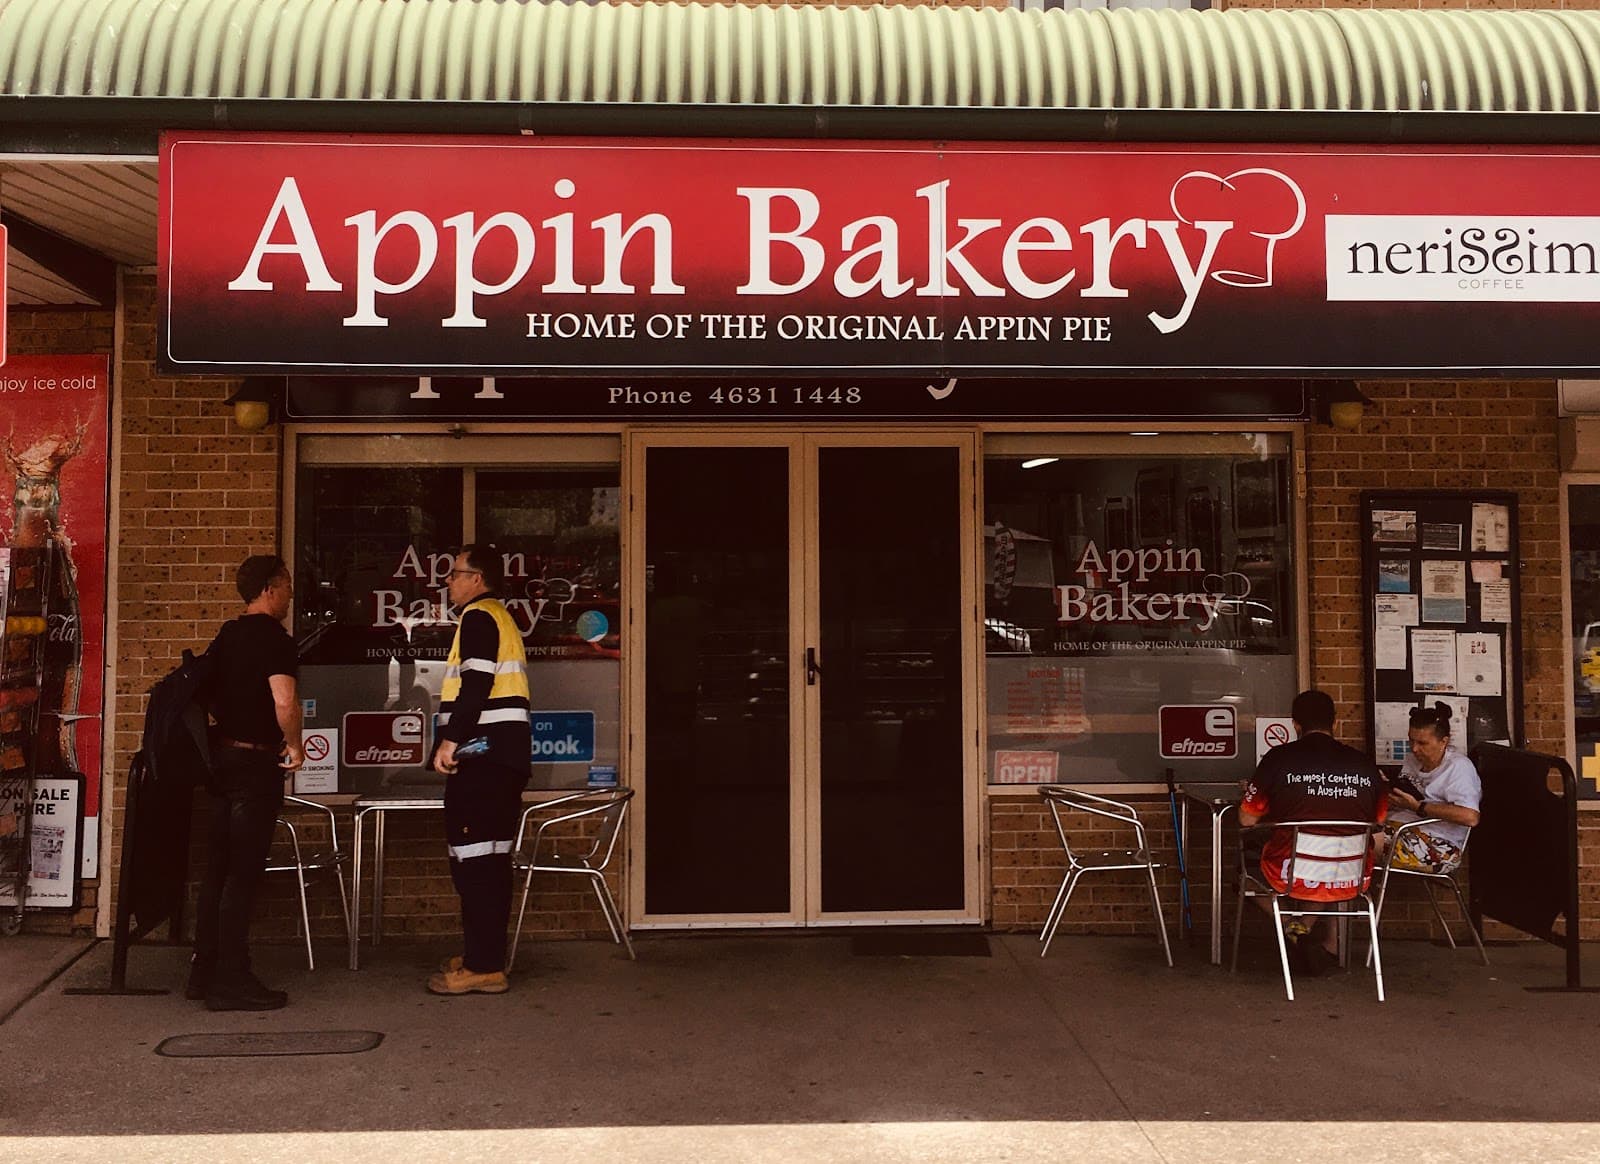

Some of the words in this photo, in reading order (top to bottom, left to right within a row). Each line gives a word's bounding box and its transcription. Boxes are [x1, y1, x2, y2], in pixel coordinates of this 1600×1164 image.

[228, 177, 686, 328] Appin
[736, 178, 1233, 334] Bakery
[1458, 279, 1524, 289] COFFEE
[526, 313, 635, 339] HOME
[646, 313, 692, 339] OF
[701, 314, 767, 340] THE
[777, 315, 944, 341] ORIGINAL
[953, 316, 1053, 341] APPIN
[1062, 317, 1112, 342] PIE
[34, 376, 56, 390] ice
[61, 375, 96, 390] cold
[608, 386, 692, 404] Phone
[708, 386, 777, 404] 4631
[793, 386, 862, 404] 1448
[393, 544, 528, 588] Apn
[1075, 538, 1206, 583] Appin
[1057, 581, 1227, 631] Bakery
[367, 648, 405, 658] HOME
[407, 648, 424, 658] OF
[425, 647, 449, 657] THE
[550, 646, 569, 656] PIE
[1053, 641, 1090, 651] HOME
[1092, 641, 1108, 651] OF
[1109, 641, 1133, 650] THE
[1134, 639, 1190, 650] ORIGINAL
[1190, 639, 1228, 649] APPIN
[1229, 639, 1247, 649] PIE
[535, 721, 553, 731] on
[355, 746, 413, 762] eftpos
[1171, 737, 1227, 755] eftpos
[1000, 765, 1053, 783] OPEN
[1286, 773, 1302, 784] The
[1302, 773, 1326, 785] most
[1, 788, 24, 800] ON
[1307, 785, 1316, 796] in
[1317, 784, 1358, 800] Australia
[13, 803, 56, 815] HRE
